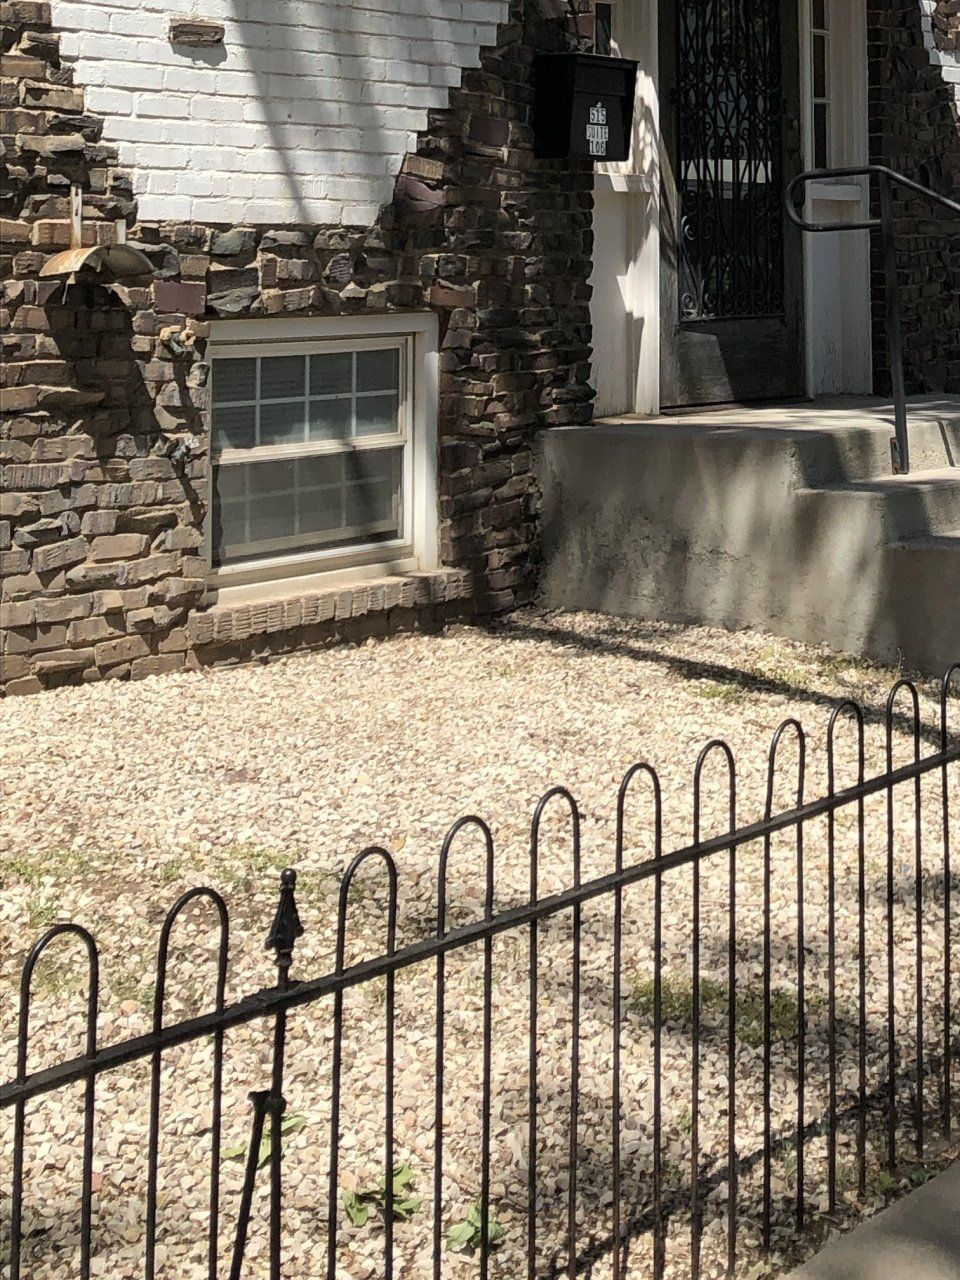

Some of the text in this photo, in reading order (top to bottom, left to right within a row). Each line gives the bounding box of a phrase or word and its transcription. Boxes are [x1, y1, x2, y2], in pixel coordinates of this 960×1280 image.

[590, 108, 606, 123] 515
[587, 125, 608, 140] SUITE
[590, 140, 606, 154] 106
